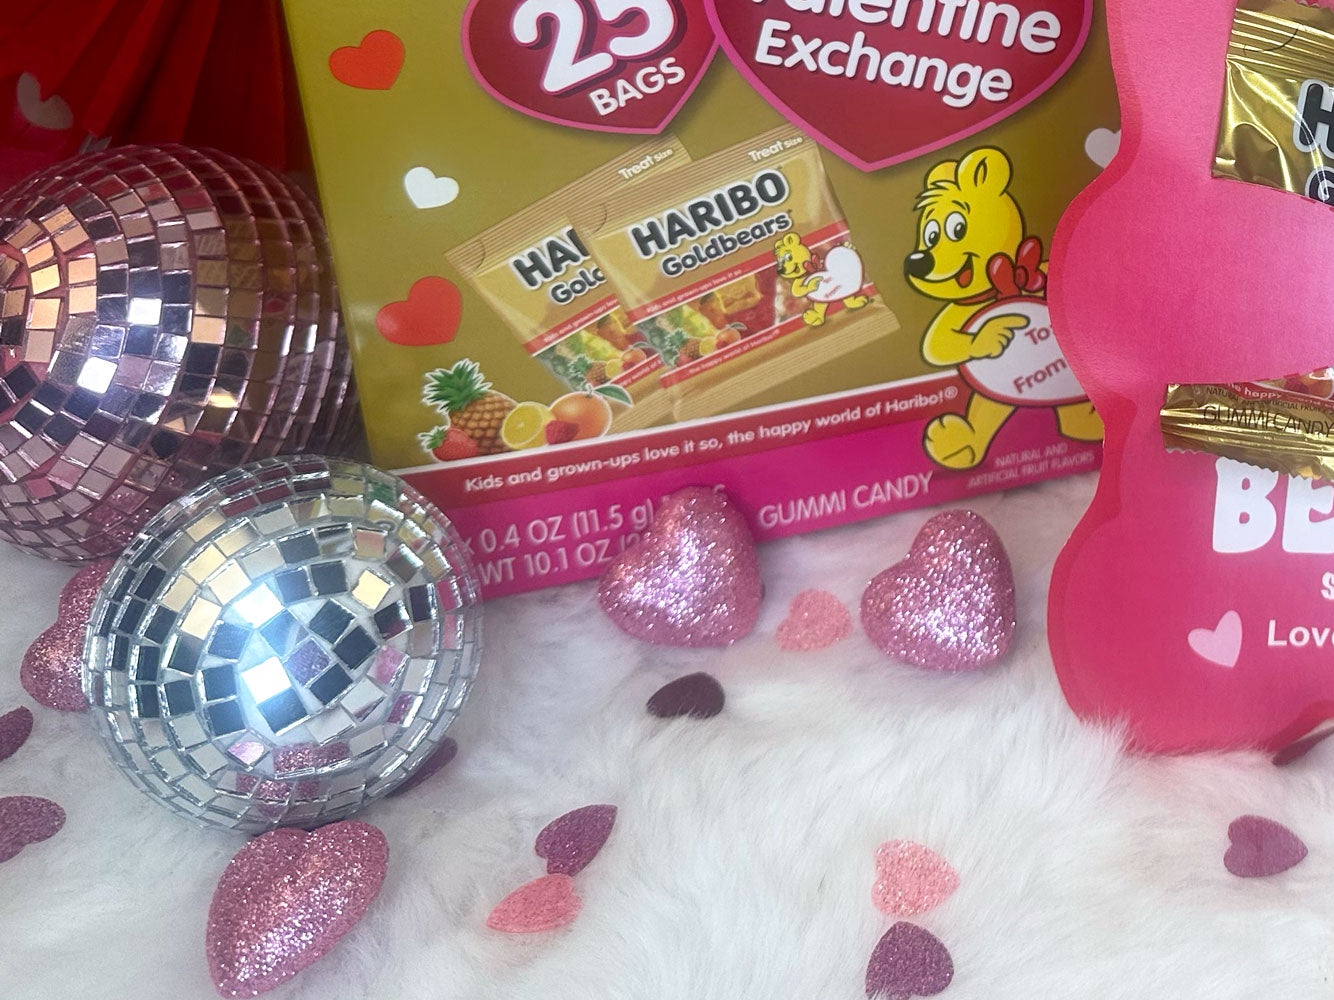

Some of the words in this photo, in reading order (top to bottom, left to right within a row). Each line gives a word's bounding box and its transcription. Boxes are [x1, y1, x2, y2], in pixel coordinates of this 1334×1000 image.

[588, 56, 687, 118] BAGS
[754, 18, 1014, 109] Exchange
[617, 155, 655, 180] Treat
[747, 140, 783, 162] Treat
[630, 169, 789, 258] HARIBO
[661, 212, 793, 278] Goldbears
[1244, 387, 1282, 399] happy
[464, 476, 503, 493] Kids
[507, 467, 542, 485] and
[546, 452, 640, 483] grown-ups
[644, 444, 680, 462] love
[683, 439, 695, 454] it
[698, 437, 724, 451] so,
[727, 426, 755, 444] the
[758, 418, 812, 439] happy
[815, 407, 861, 428] world
[865, 399, 883, 417] of
[967, 468, 1021, 490] ARTIFICIAL
[1021, 460, 1050, 478] FRUIT
[1050, 450, 1095, 472] FLAVORS
[994, 448, 1042, 469] NATURAL
[1044, 442, 1069, 457] AND
[757, 489, 846, 530] GUMMI
[852, 470, 934, 509] CANDY
[479, 523, 521, 554] 0.4
[526, 515, 566, 545] OZ
[570, 503, 624, 540] (11.5
[477, 556, 516, 586] WT
[524, 546, 570, 577] 10.1
[575, 538, 613, 567] OZ
